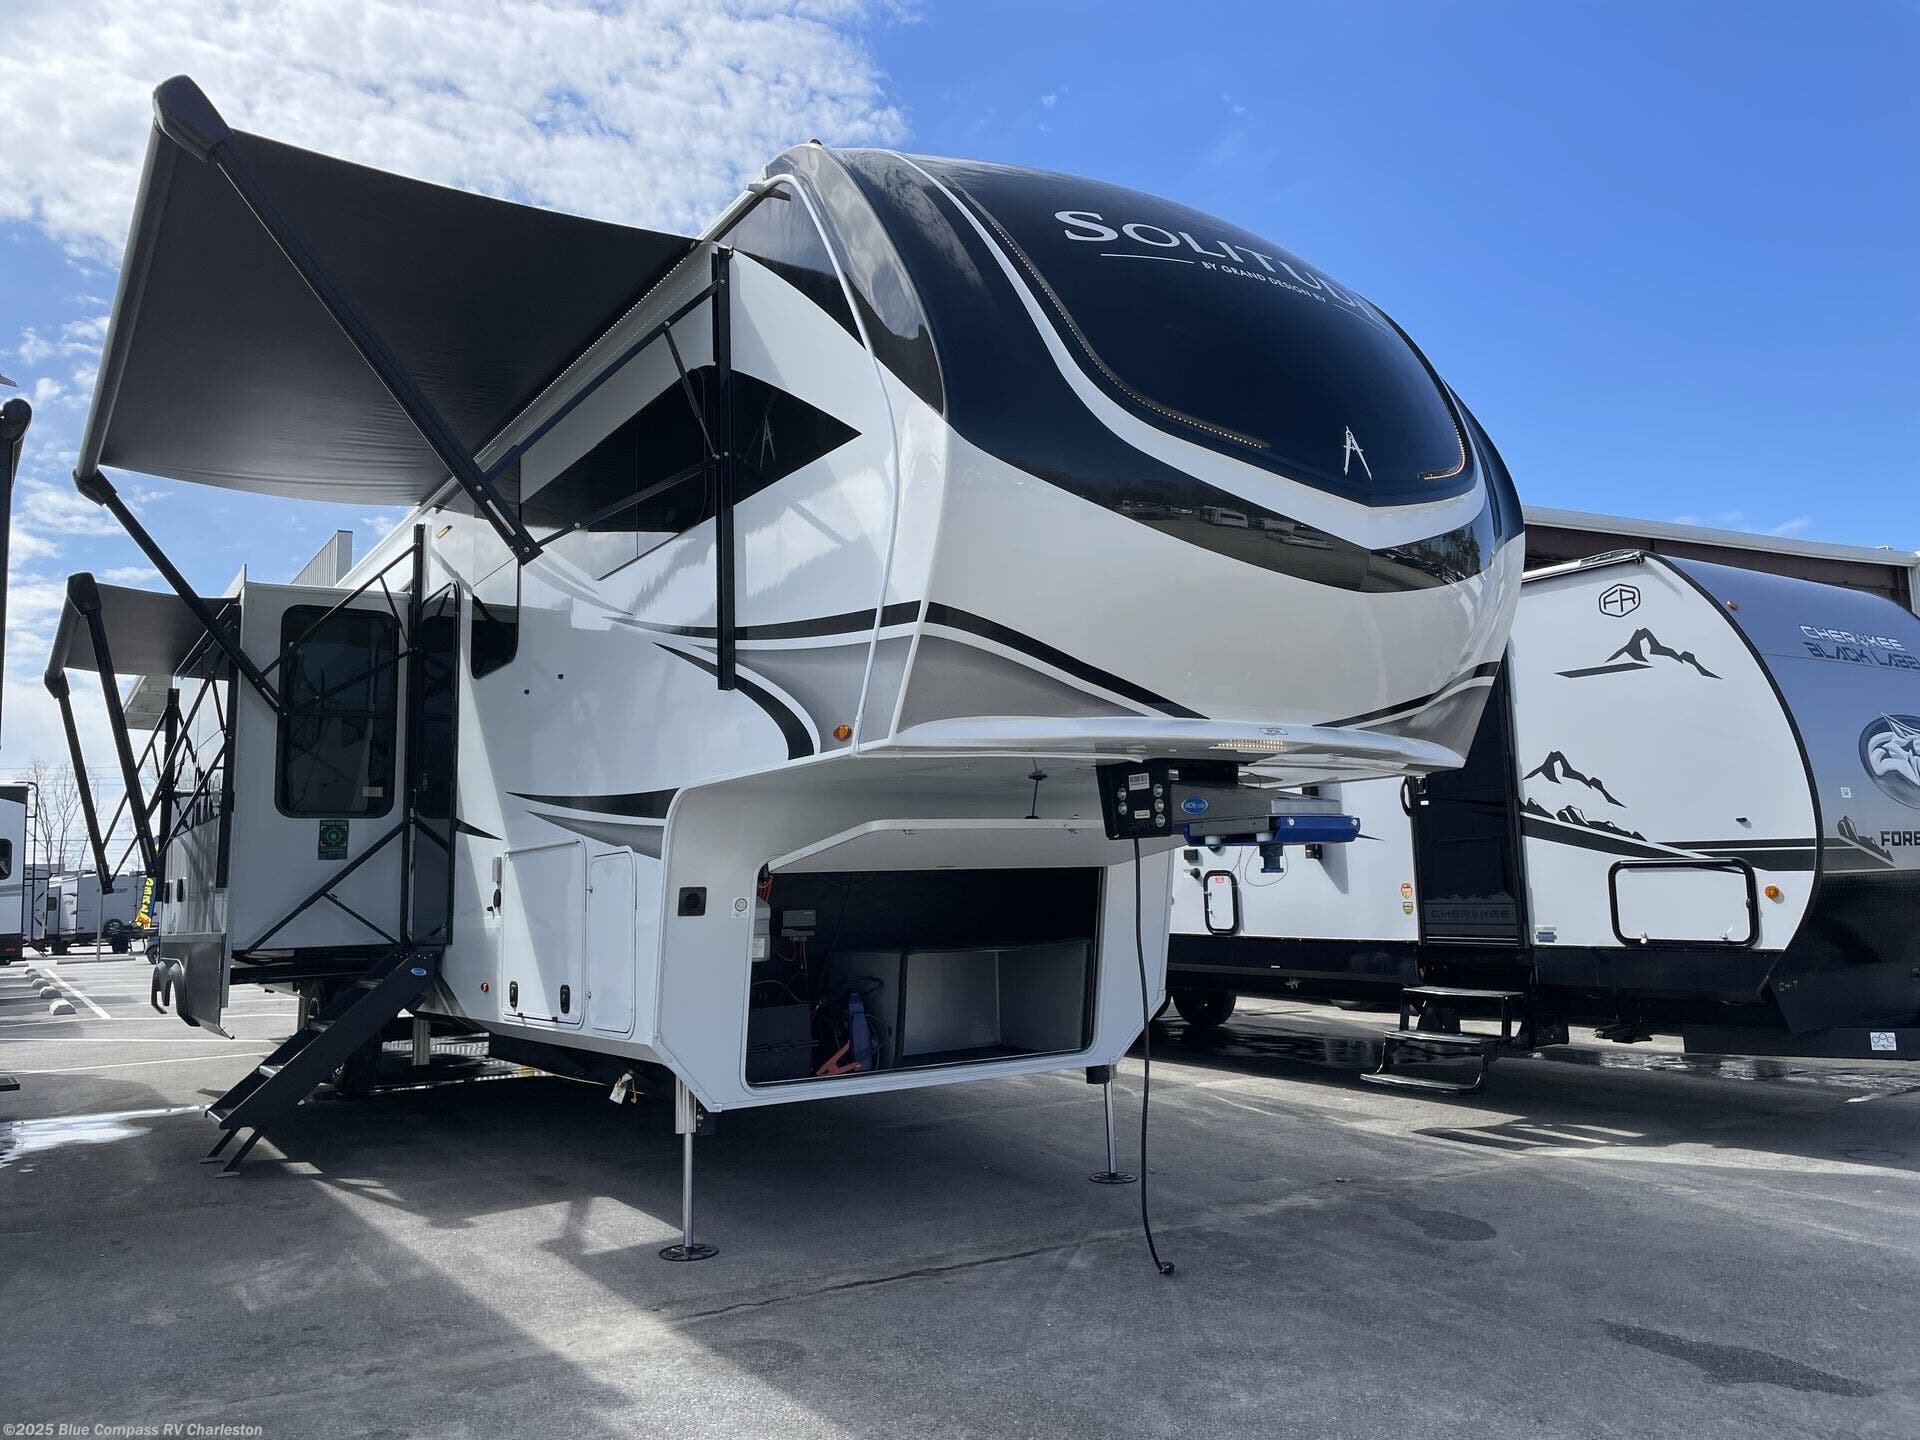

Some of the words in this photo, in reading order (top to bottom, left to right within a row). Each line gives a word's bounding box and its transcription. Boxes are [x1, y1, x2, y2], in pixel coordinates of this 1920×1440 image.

[1201, 261, 1218, 271] BY
[1221, 265, 1266, 282] GRAND
[1269, 277, 1312, 297] DESIGN
[1799, 624, 1905, 652] CHEROKEE
[1803, 641, 1871, 664] BLACK
[1880, 831, 1920, 846] FORE
[1430, 909, 1513, 920] CHEROKEE
